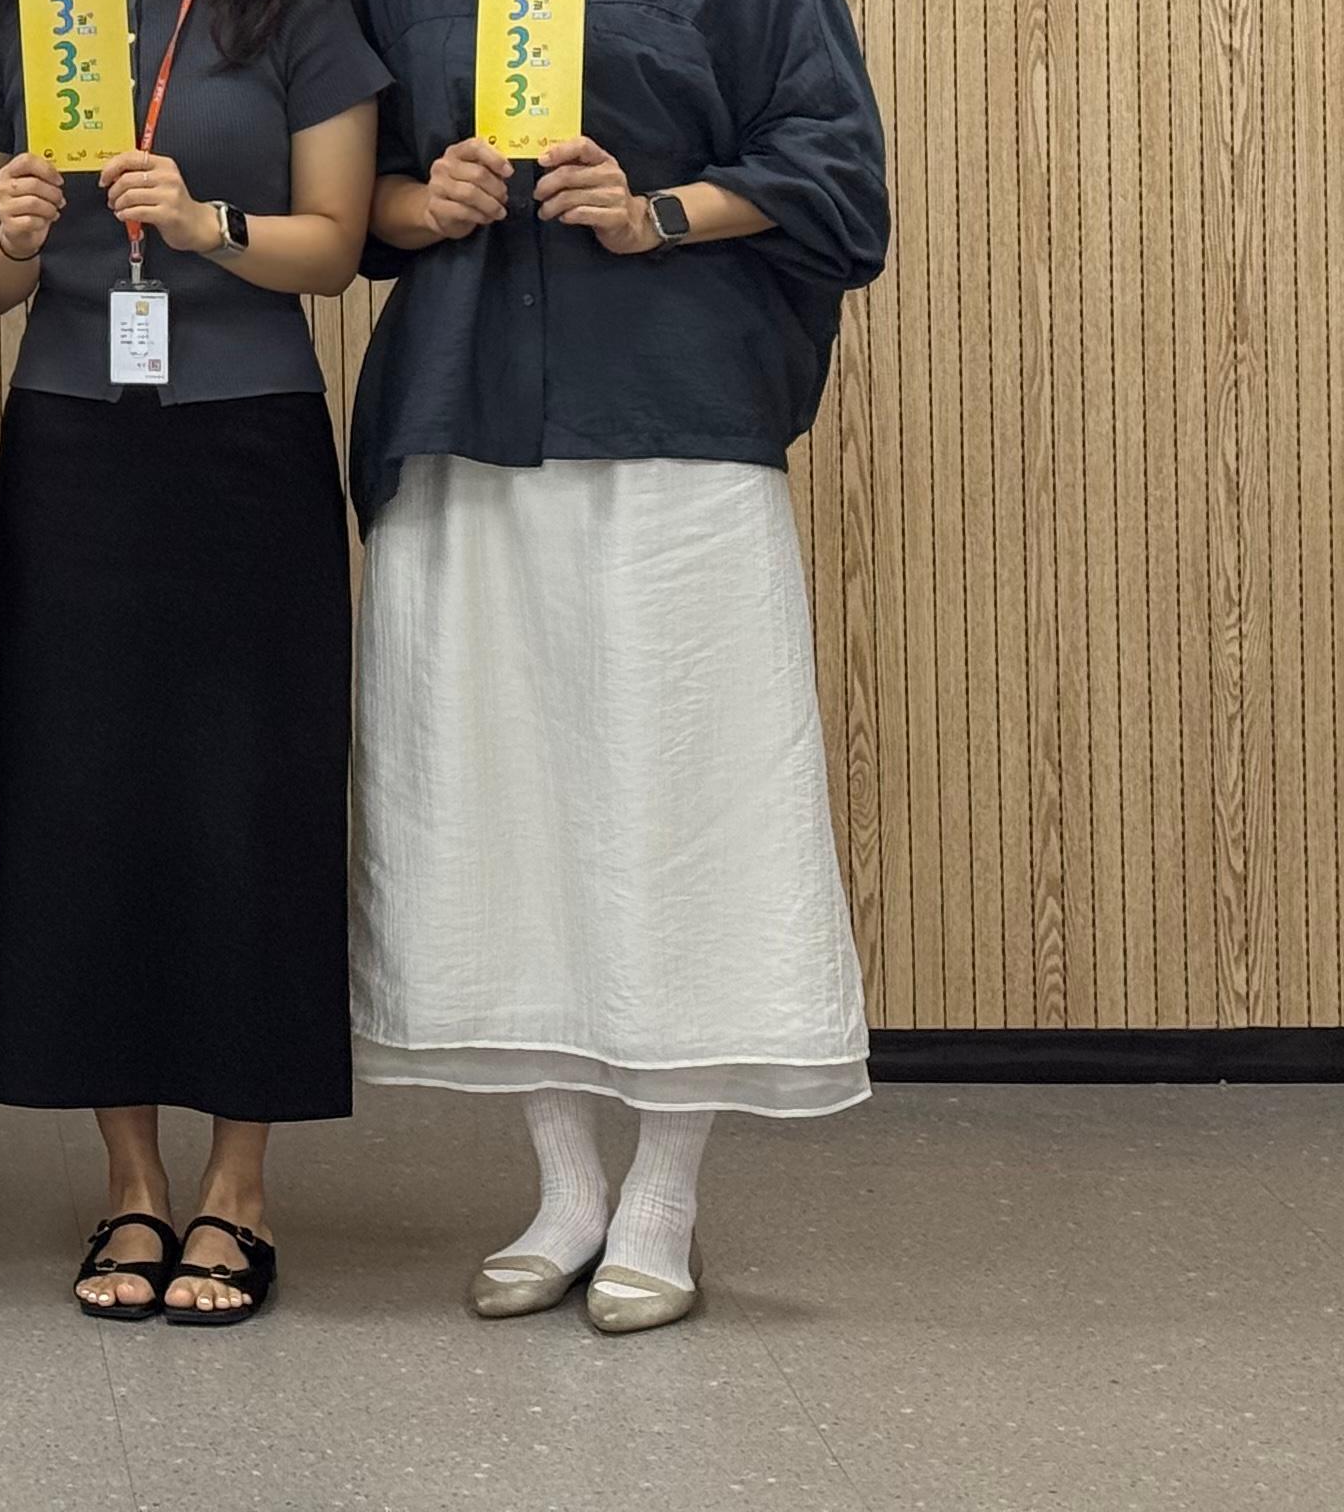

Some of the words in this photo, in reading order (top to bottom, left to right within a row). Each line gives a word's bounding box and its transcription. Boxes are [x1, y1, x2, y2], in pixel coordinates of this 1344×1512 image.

[53, 41, 77, 83] 3
[507, 26, 530, 69] 3
[56, 88, 81, 131] 3
[504, 73, 528, 117] 3
